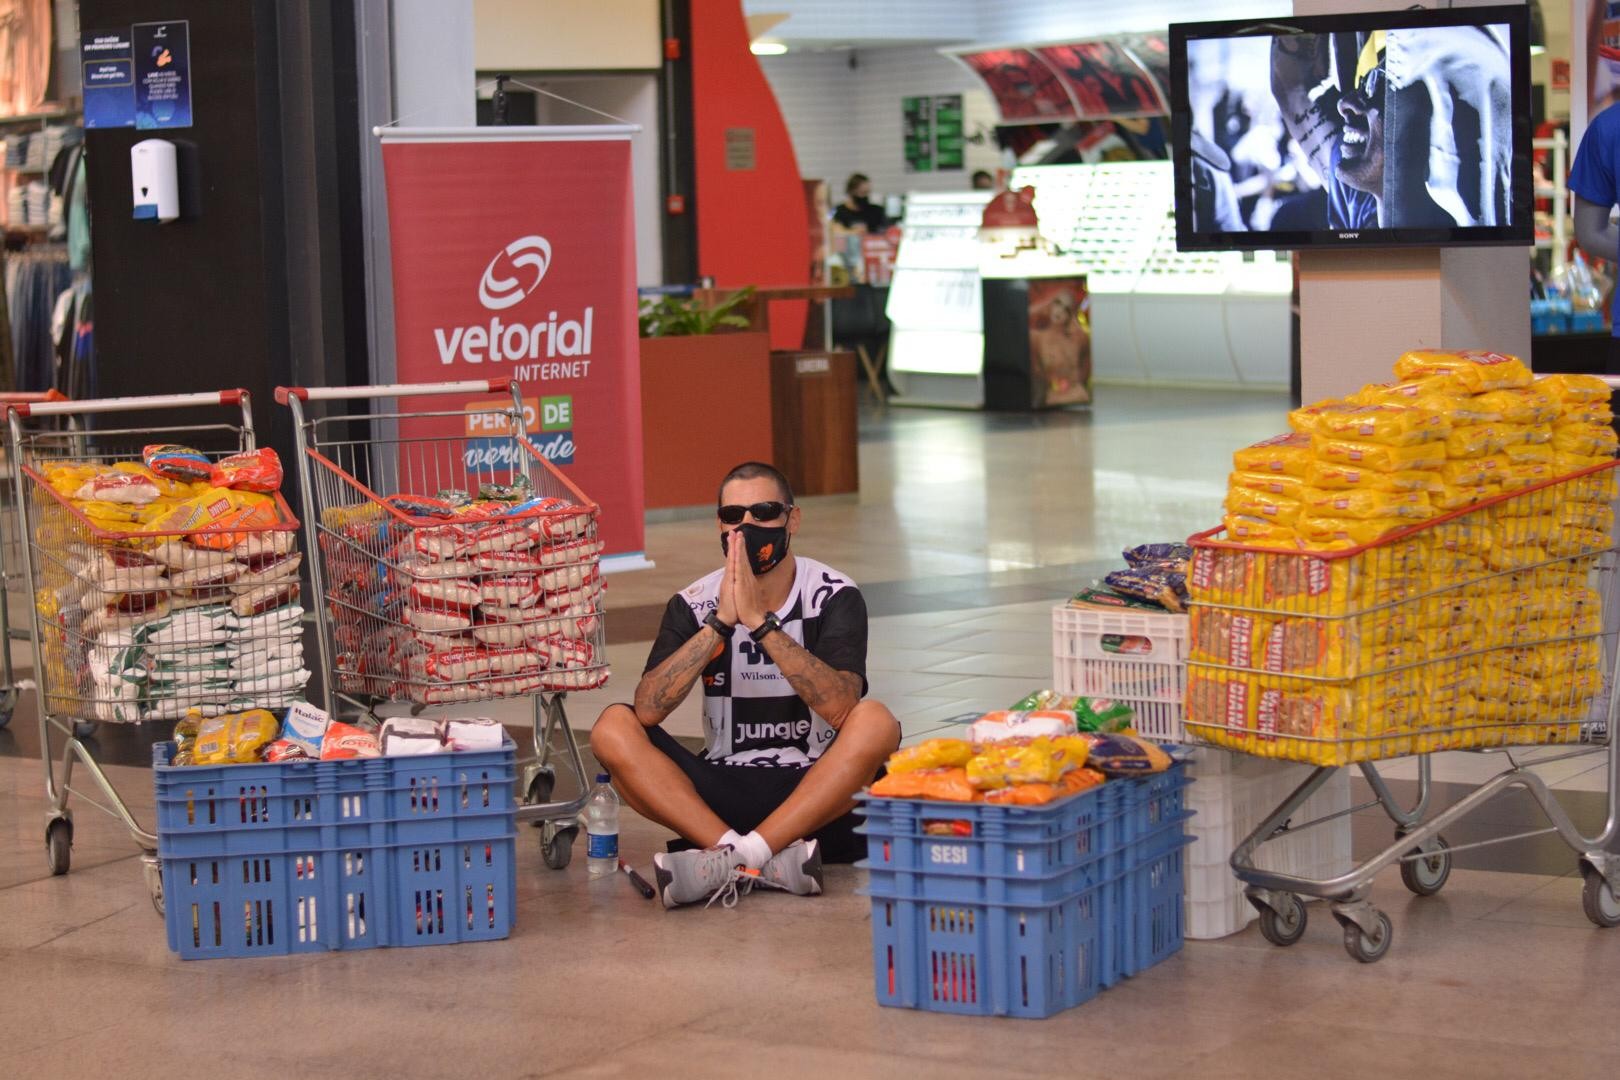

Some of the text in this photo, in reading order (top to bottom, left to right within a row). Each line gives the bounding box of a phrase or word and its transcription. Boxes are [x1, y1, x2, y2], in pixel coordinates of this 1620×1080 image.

[434, 307, 594, 365] vetorial
[514, 360, 591, 381] INTERNET
[544, 403, 570, 424] DE
[1231, 616, 1251, 667] DIANA
[741, 671, 786, 681] Wilson.S
[294, 706, 325, 723] Italac
[734, 719, 811, 744] jungle
[816, 729, 834, 744] Lo
[931, 845, 968, 864] SESI
